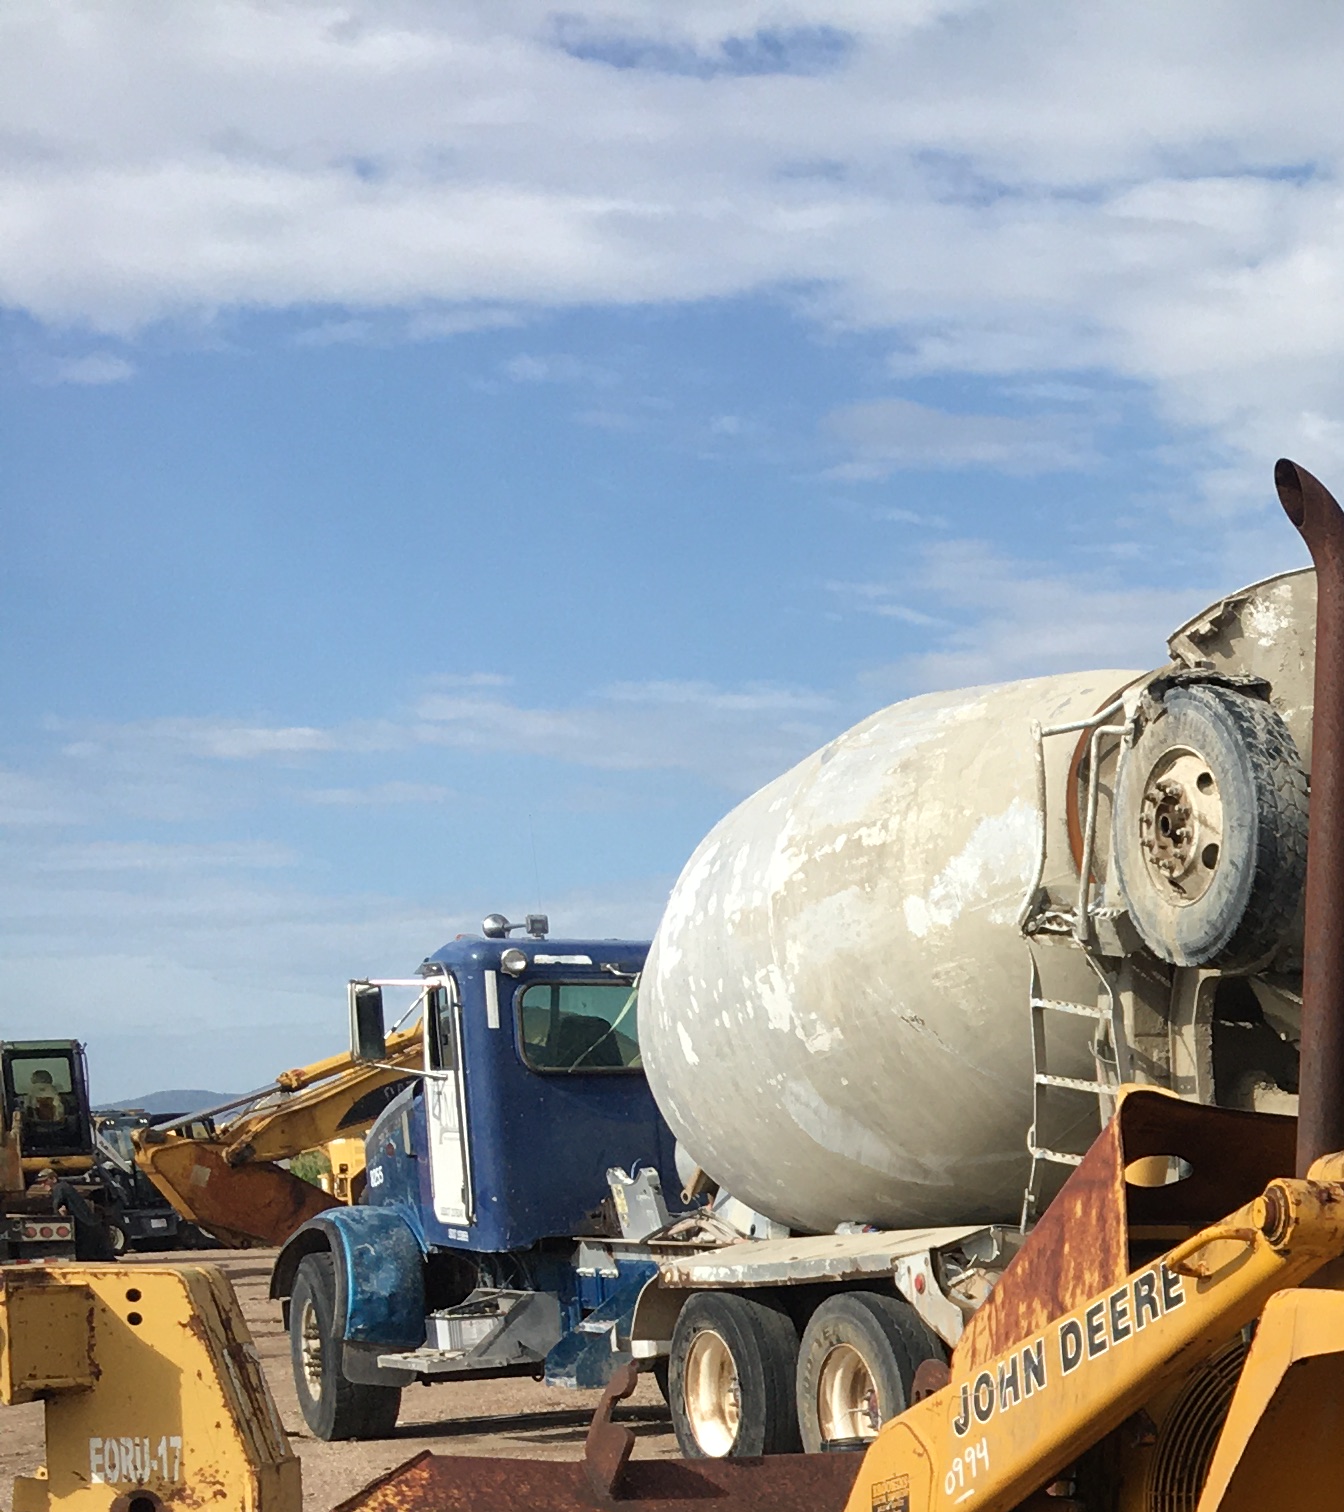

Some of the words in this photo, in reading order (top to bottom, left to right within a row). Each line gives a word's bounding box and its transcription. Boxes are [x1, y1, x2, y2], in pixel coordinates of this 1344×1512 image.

[953, 1337, 1047, 1437] JOHN
[1058, 1260, 1186, 1376] DEERE
[944, 1437, 990, 1496] 0994
